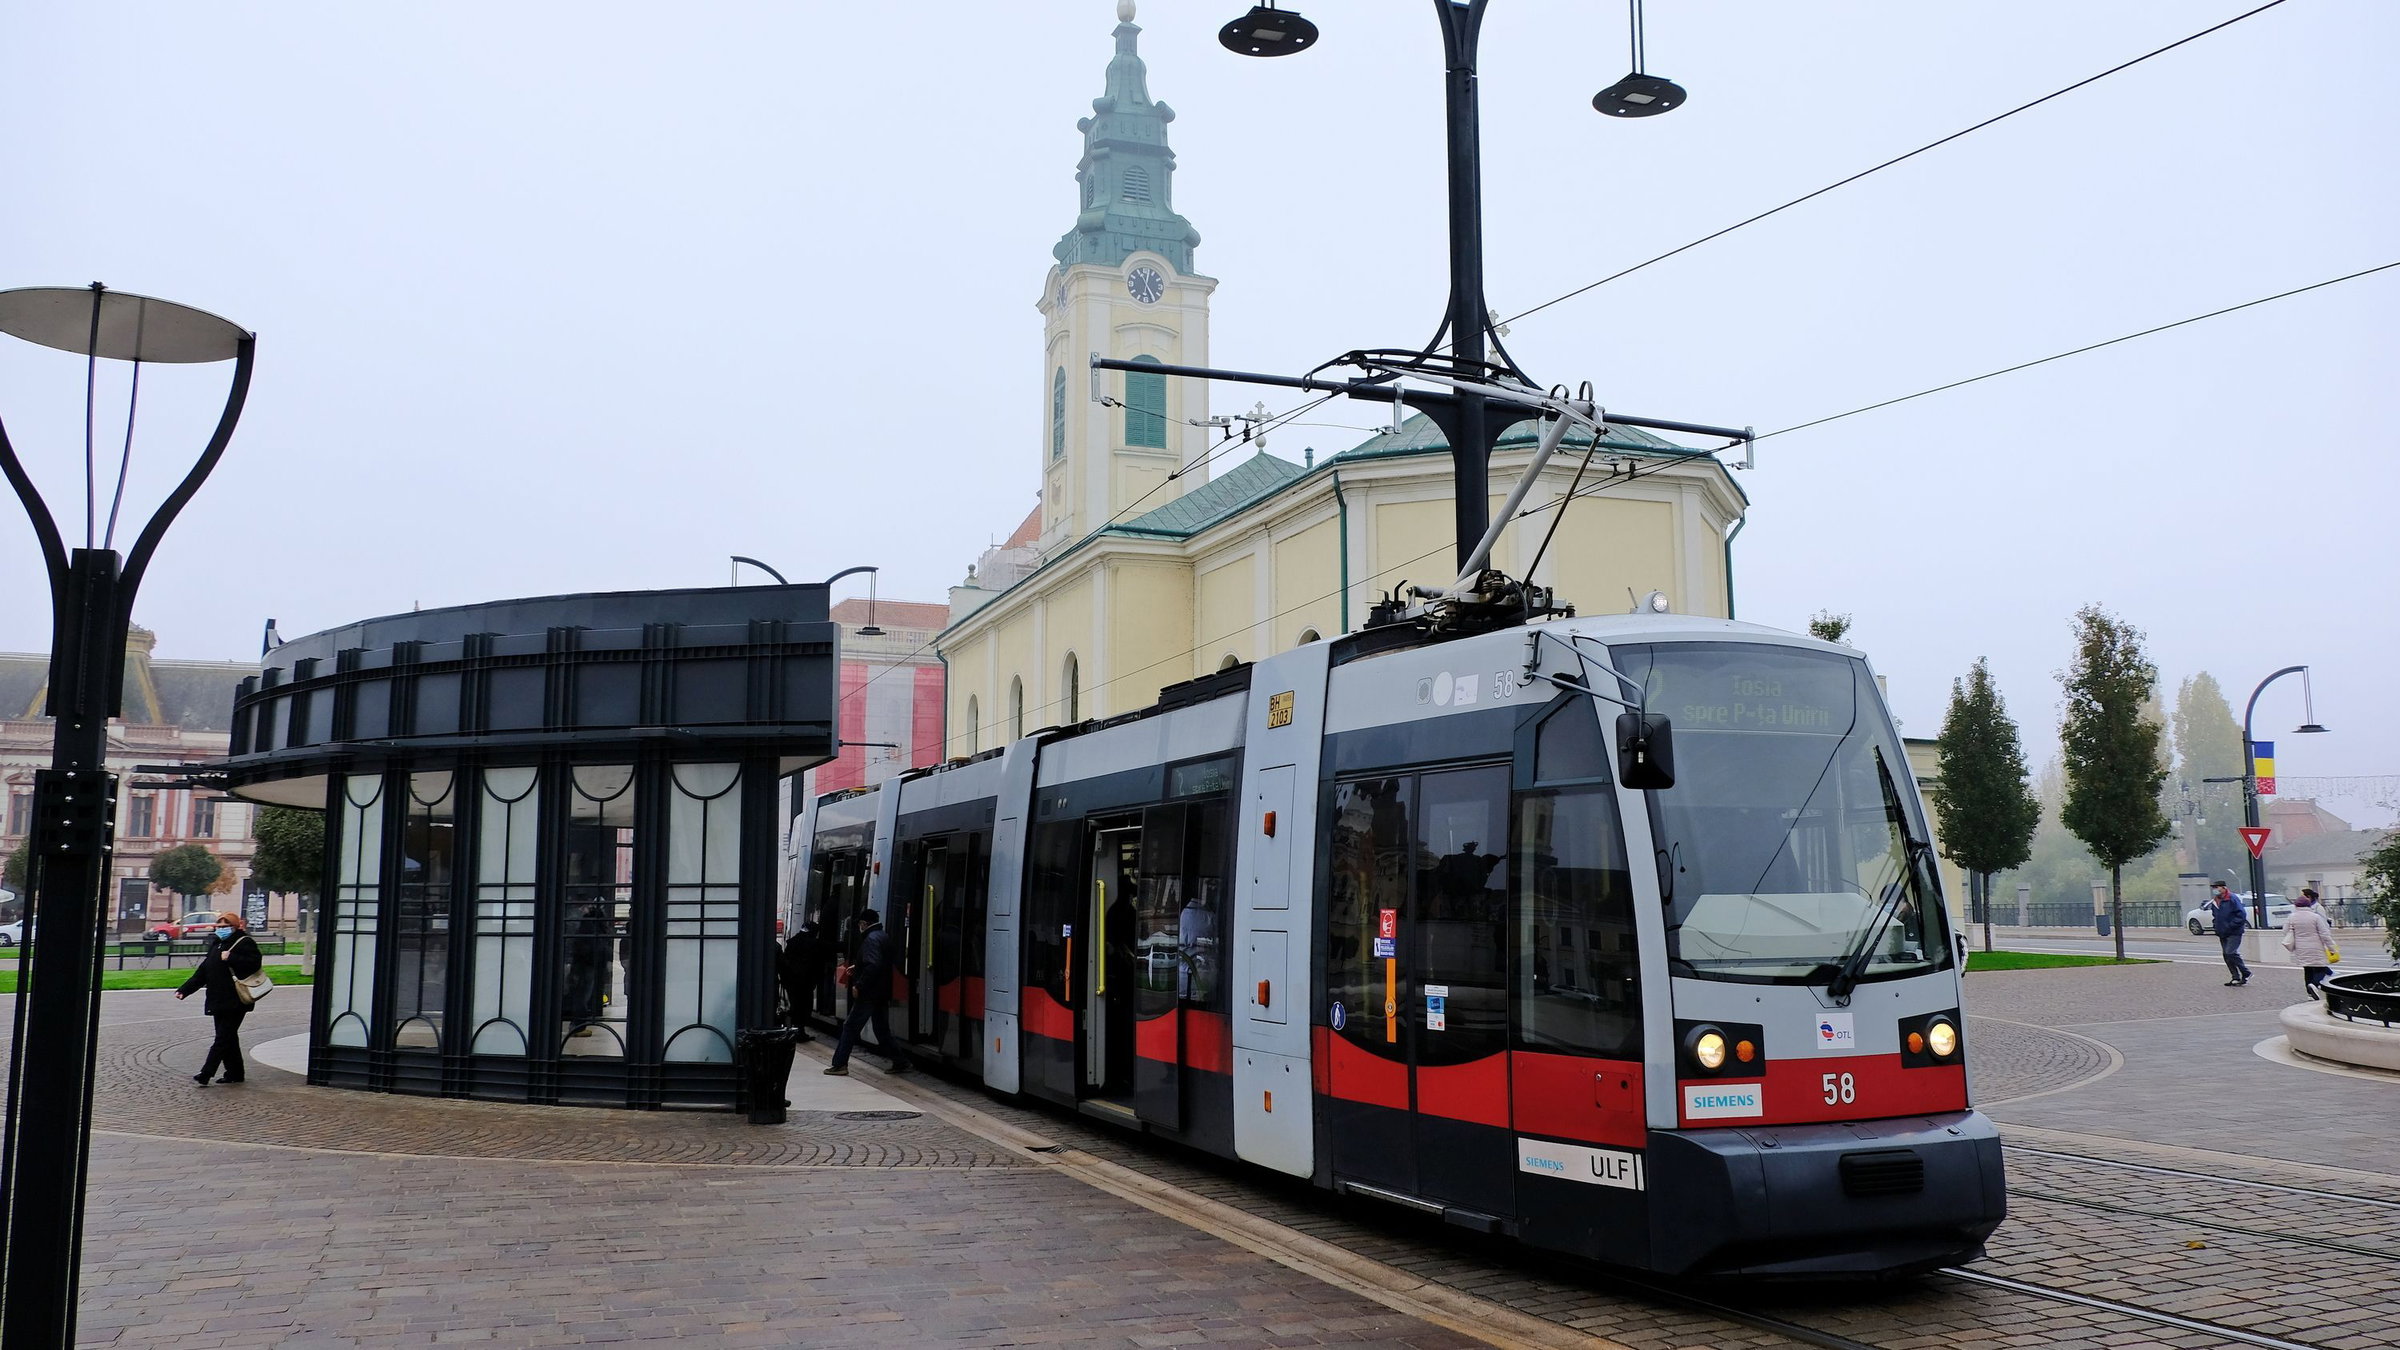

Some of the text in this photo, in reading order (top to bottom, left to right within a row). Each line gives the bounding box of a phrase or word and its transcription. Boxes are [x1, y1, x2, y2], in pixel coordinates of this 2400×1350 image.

[1493, 670, 1514, 699] 58
[1731, 675, 1783, 697] Iosia
[1270, 696, 1280, 711] BH
[1271, 710, 1288, 726] 2103
[1683, 705, 1728, 725] spre
[1782, 704, 1832, 726] Unirii
[1837, 1031, 1852, 1039] OTL
[1822, 1072, 1856, 1106] 58
[1694, 1095, 1754, 1108] SIEMENS
[1526, 1155, 1628, 1180] SIEMENS ULF
